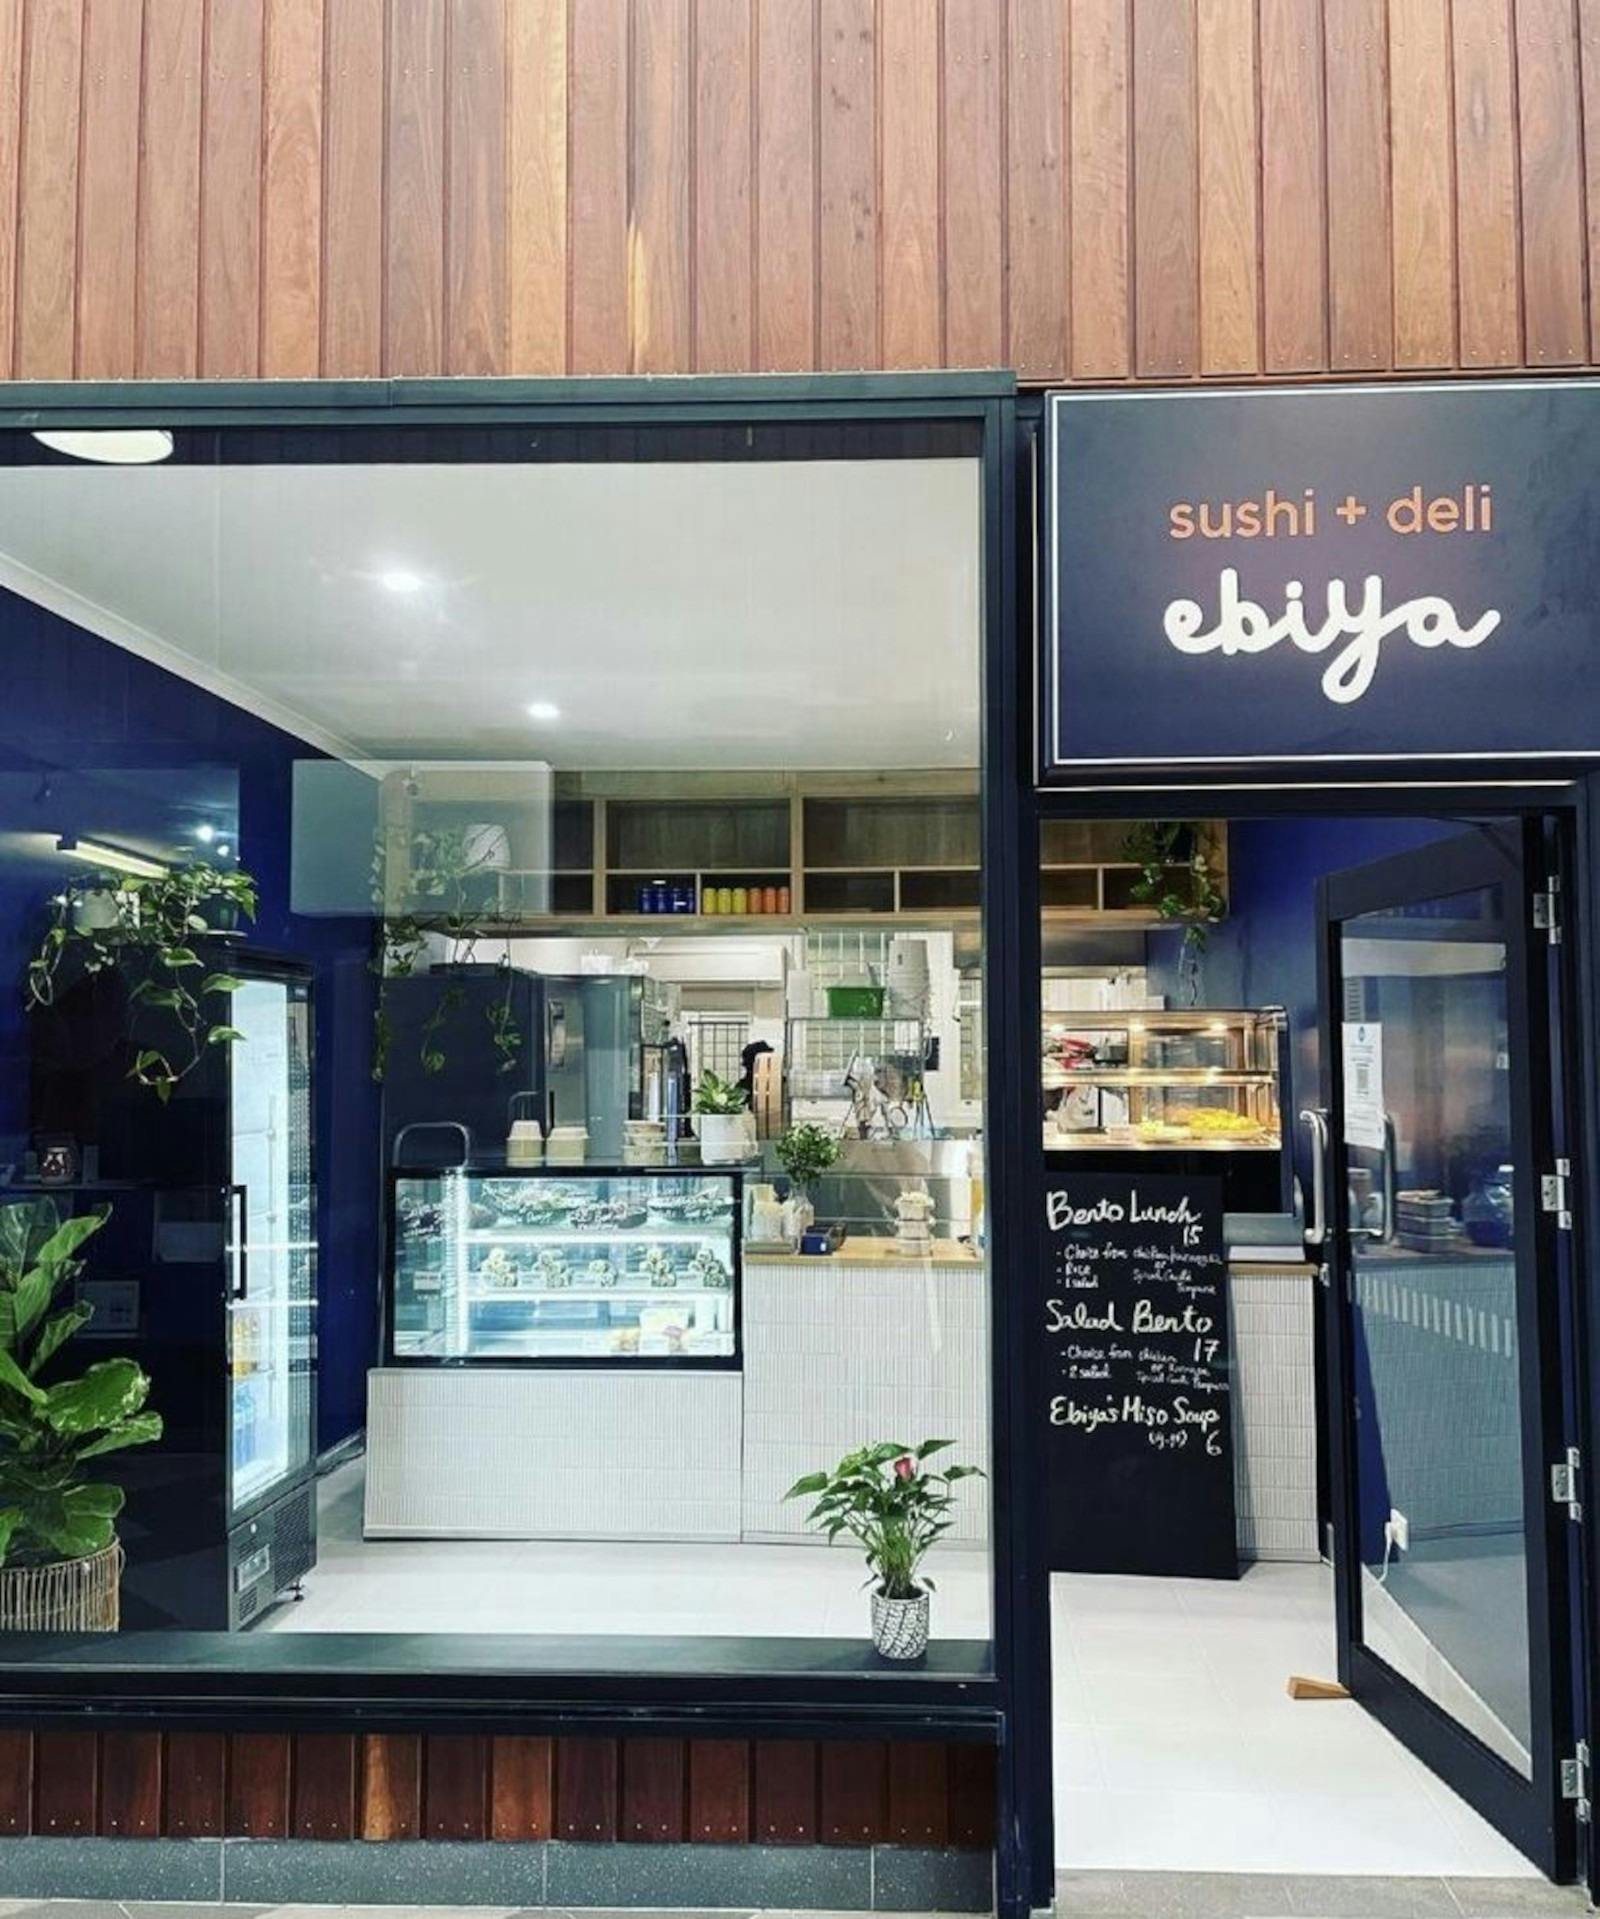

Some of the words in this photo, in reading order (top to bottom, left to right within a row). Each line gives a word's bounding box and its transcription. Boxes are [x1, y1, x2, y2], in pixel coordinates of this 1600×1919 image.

[1170, 487, 1316, 539] sushi
[1336, 496, 1367, 525] +
[1387, 484, 1492, 534] deli
[1163, 567, 1501, 704] ebiya
[1046, 1190, 1124, 1231] Bento
[1130, 1189, 1202, 1224] Lunch
[1183, 1225, 1203, 1246] 15
[1046, 1299, 1124, 1333] Salad
[1132, 1299, 1213, 1334] Bento
[1193, 1337, 1220, 1362] 17
[1050, 1395, 1120, 1433] Ebiya's
[1122, 1395, 1168, 1426] Miso
[1173, 1396, 1220, 1433] Soup
[1206, 1430, 1222, 1456] 6
